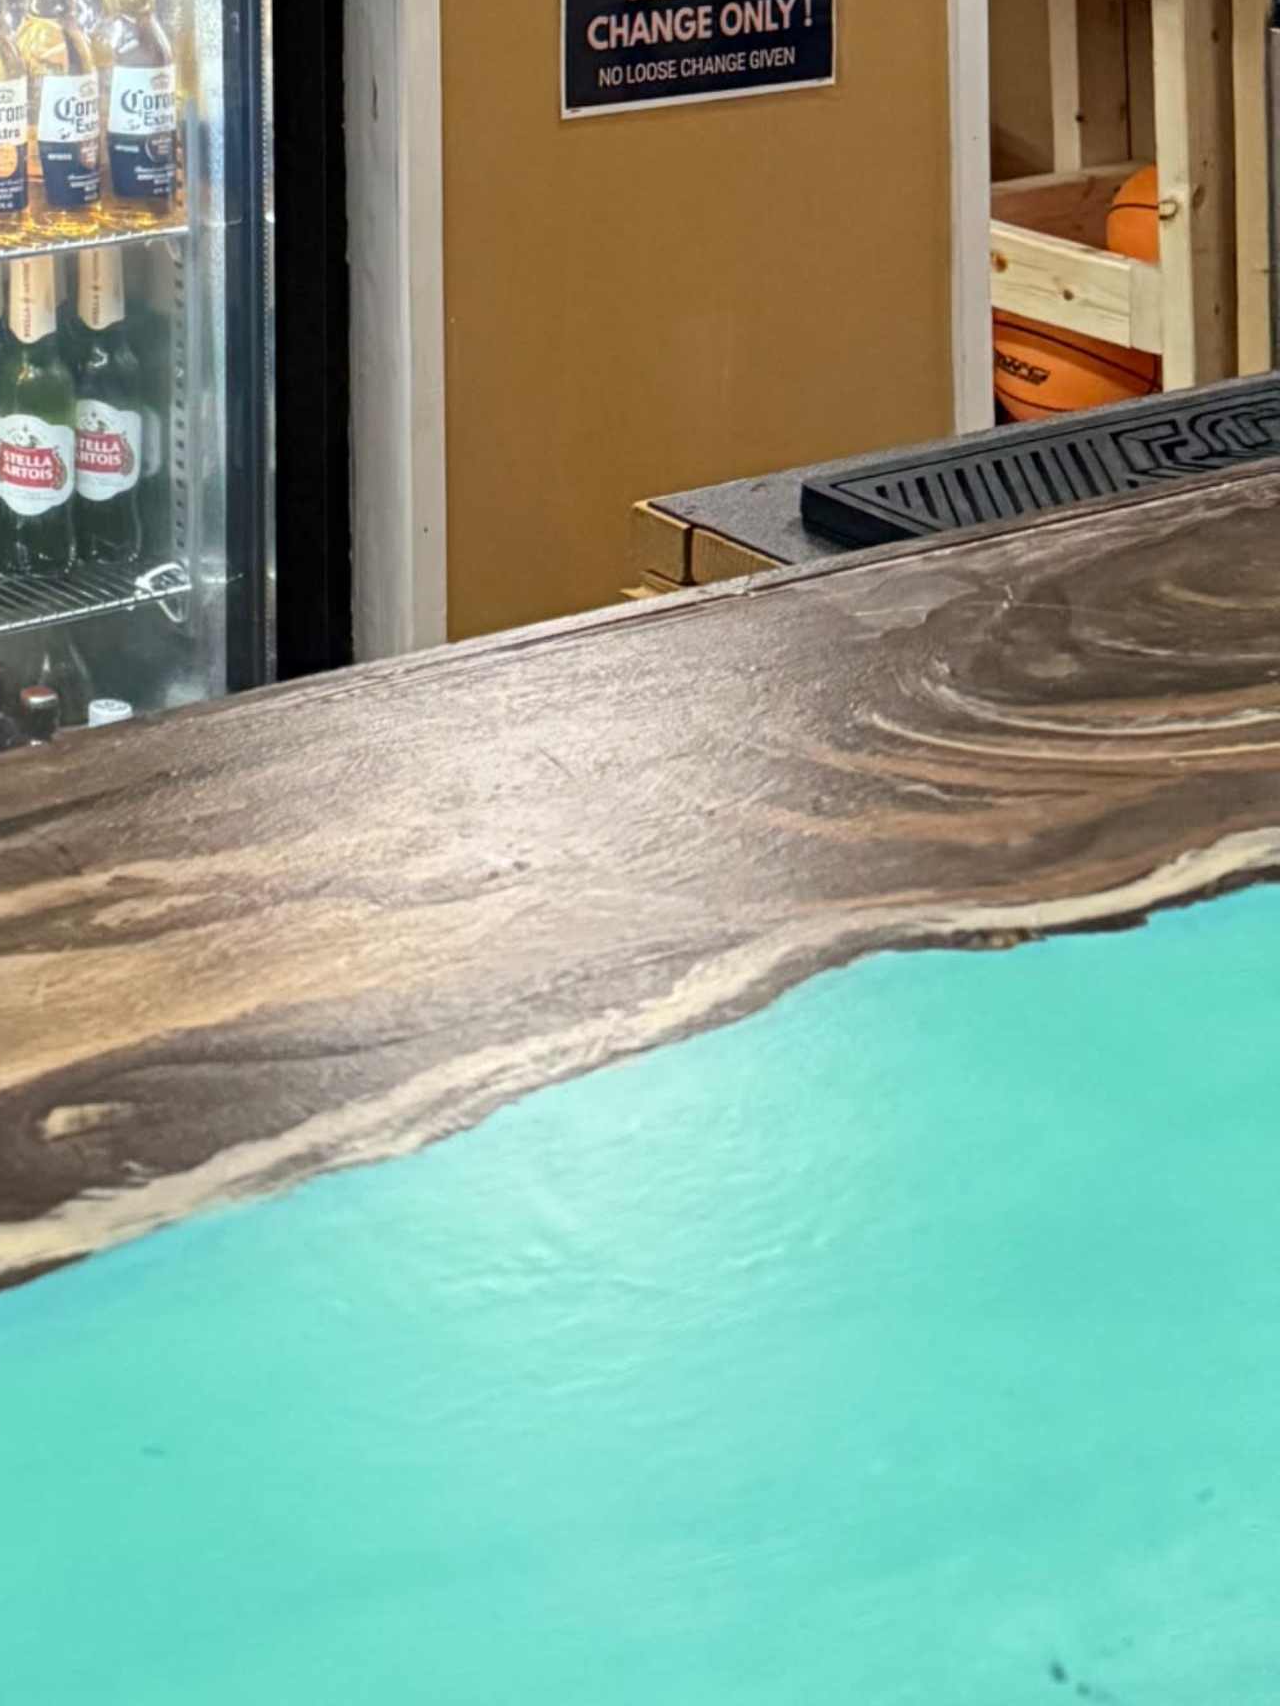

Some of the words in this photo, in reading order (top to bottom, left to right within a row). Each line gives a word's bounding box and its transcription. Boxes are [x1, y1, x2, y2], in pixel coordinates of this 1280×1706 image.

[586, 5, 713, 51] CHANGE
[597, 67, 624, 87] NO
[626, 59, 679, 84] LOOSE
[680, 51, 747, 79] CHANGE
[749, 46, 796, 70] GIVEN
[2, 465, 54, 481] ARTOIS
[3, 451, 52, 468] STELLA
